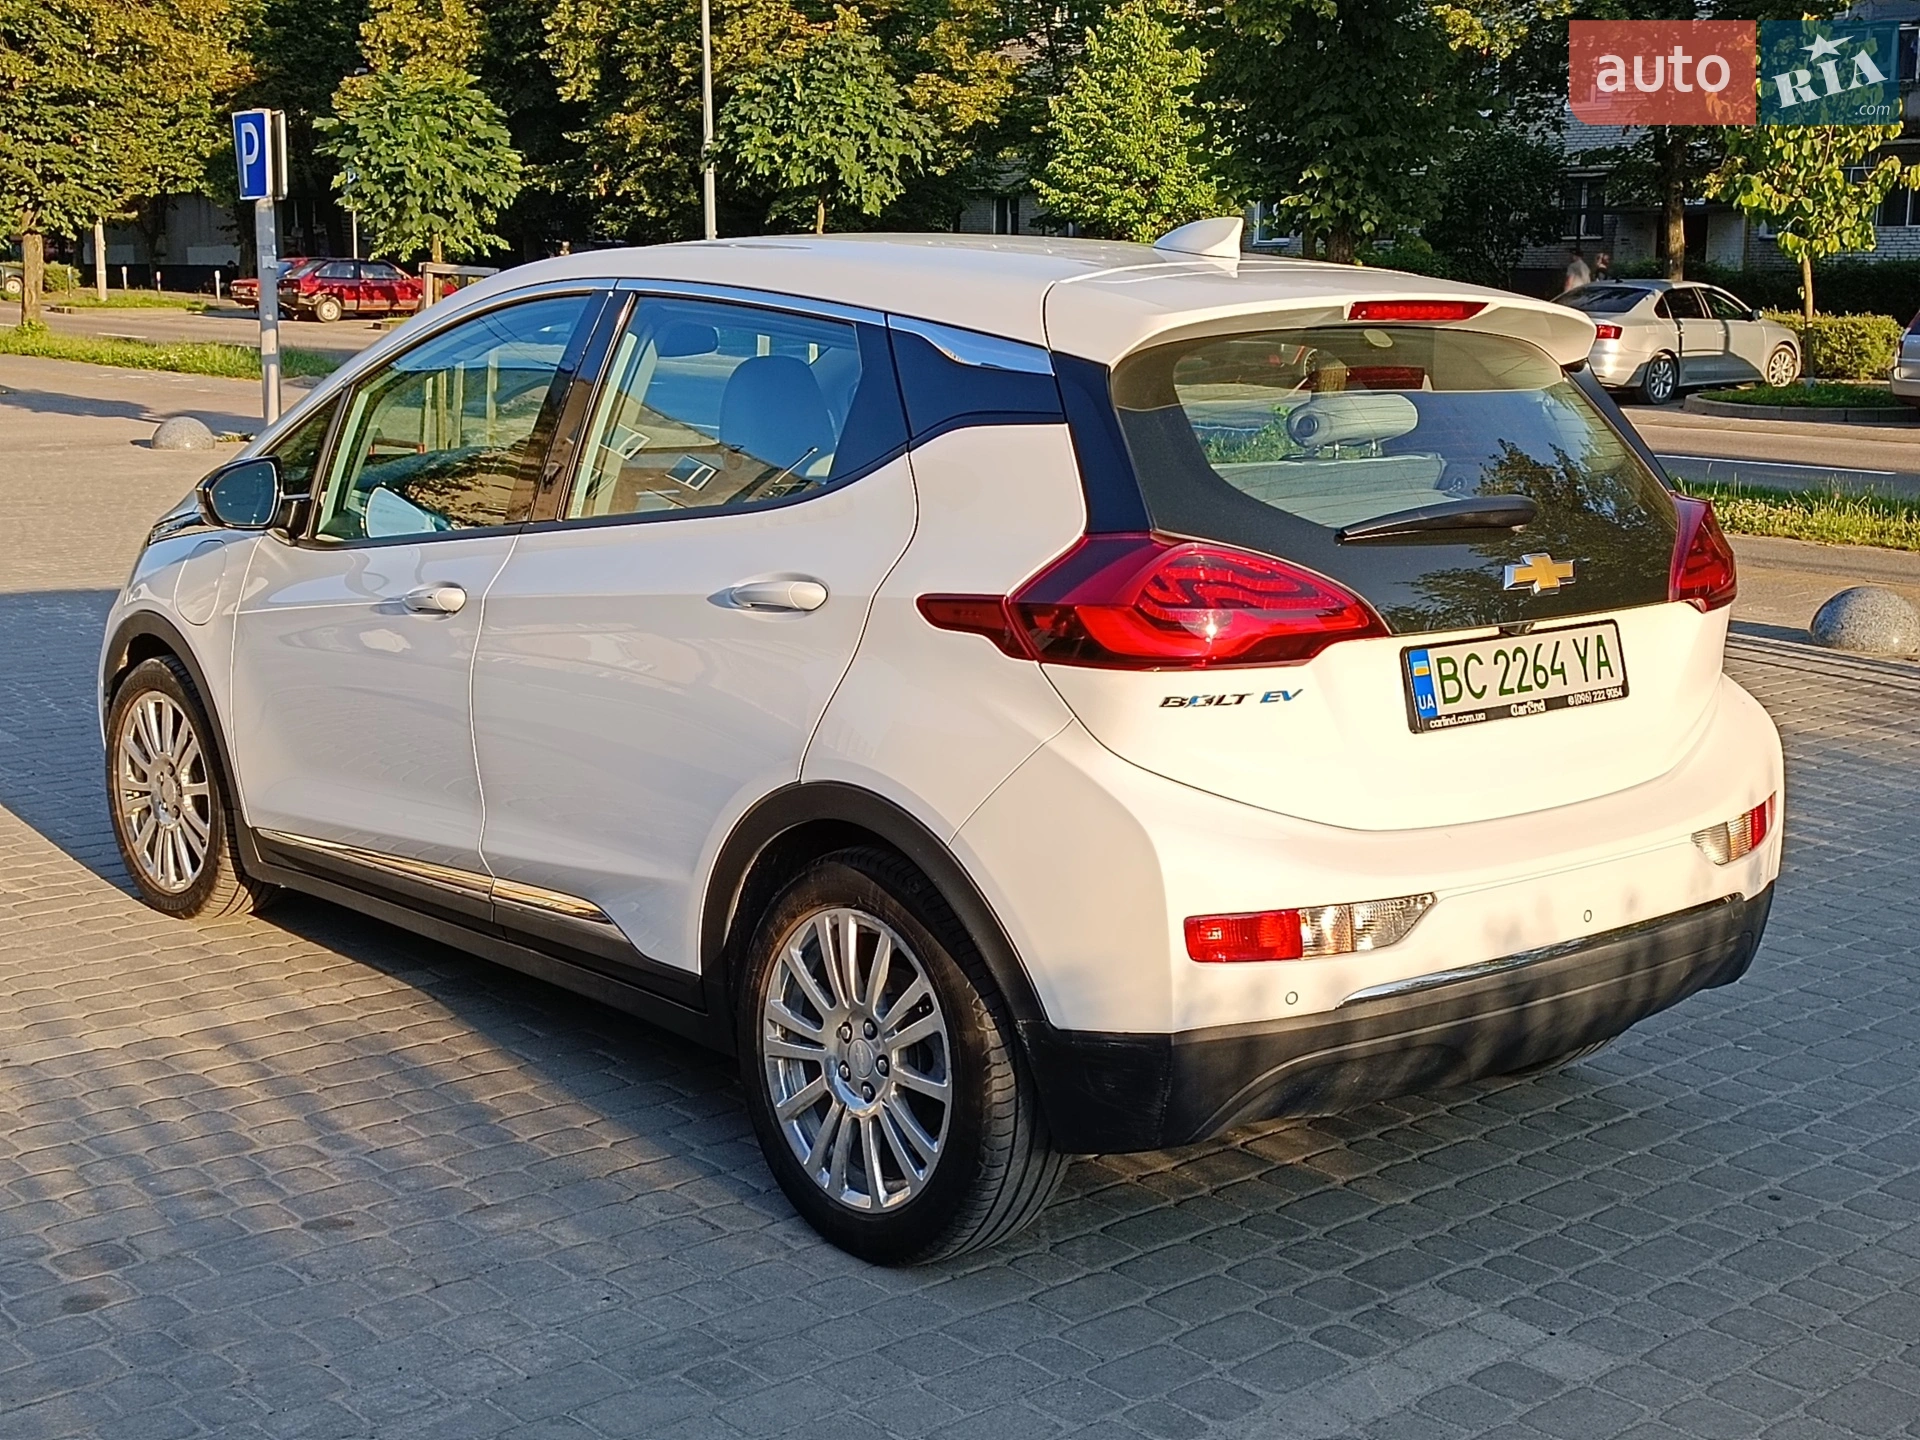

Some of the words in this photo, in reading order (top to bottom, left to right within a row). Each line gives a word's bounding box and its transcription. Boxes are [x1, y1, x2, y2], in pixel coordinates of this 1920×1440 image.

[240, 122, 260, 189] P
[1436, 652, 1488, 705] BC
[1493, 640, 1568, 697] 2264
[1572, 634, 1615, 683] YA
[1159, 692, 1254, 708] BOLT
[1260, 688, 1304, 704] EV
[1418, 693, 1436, 710] UA
